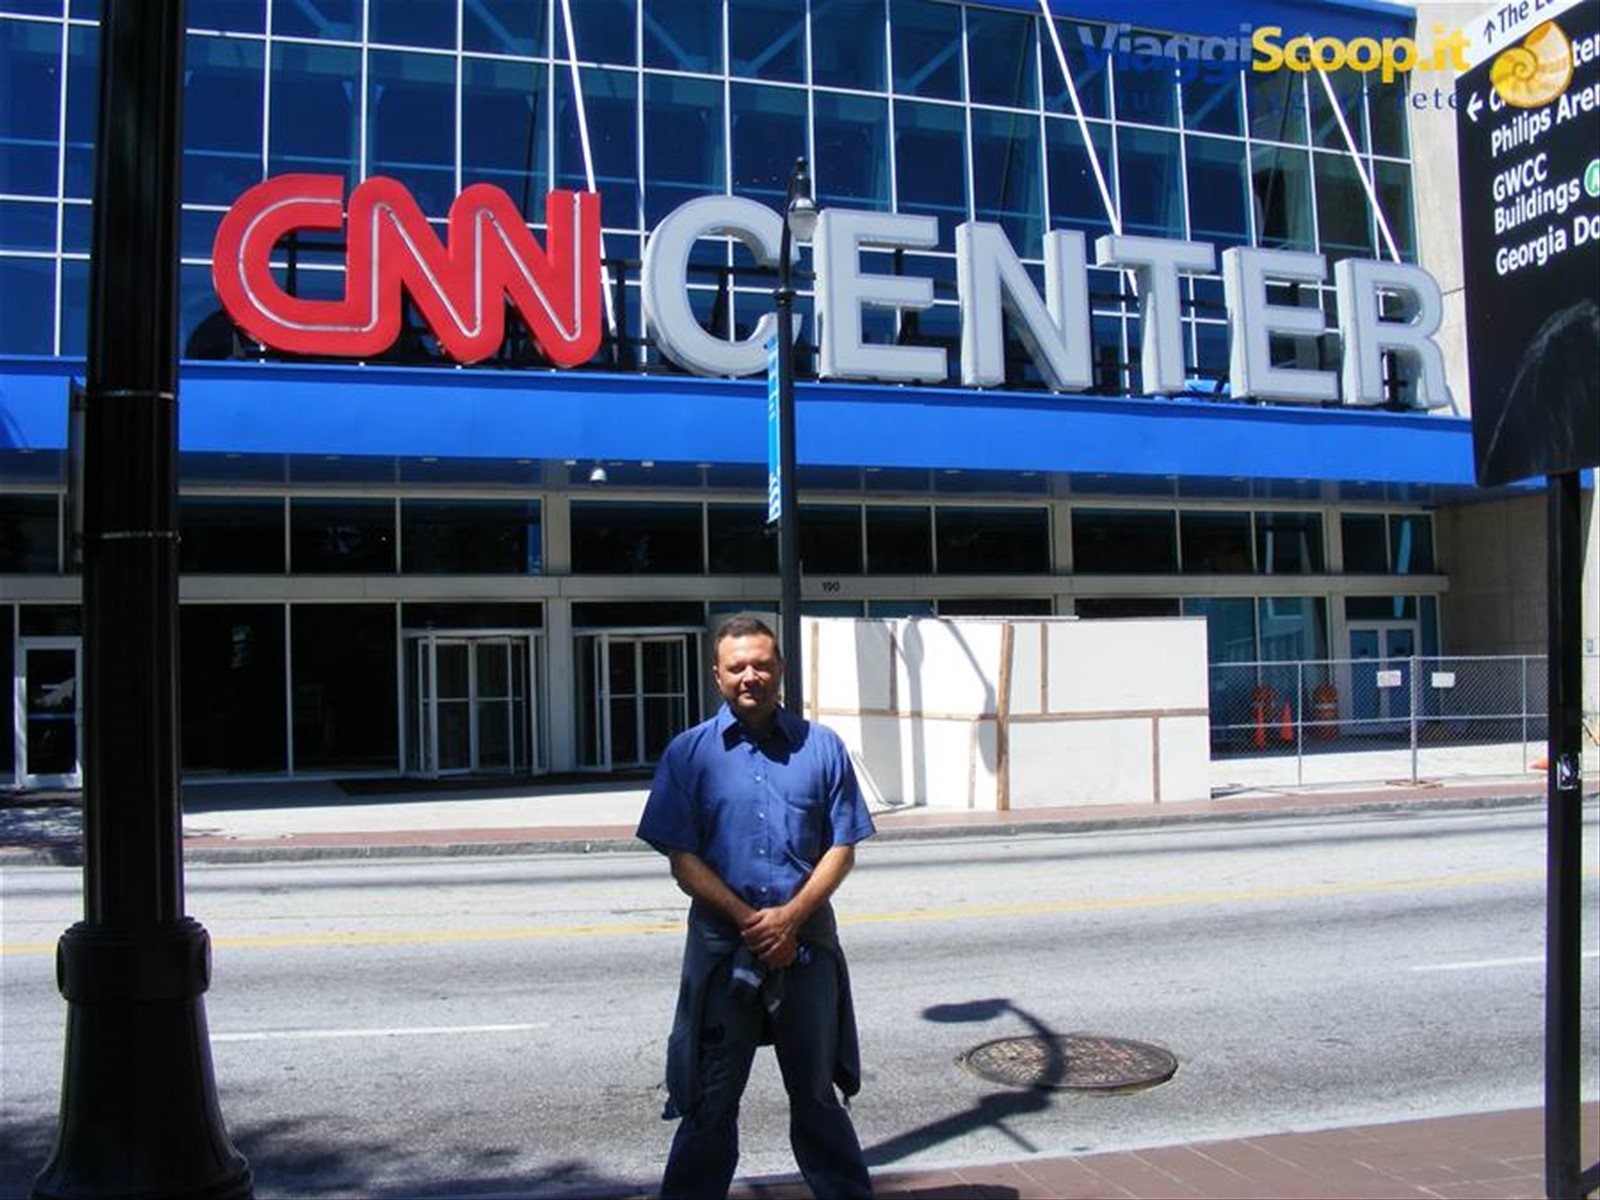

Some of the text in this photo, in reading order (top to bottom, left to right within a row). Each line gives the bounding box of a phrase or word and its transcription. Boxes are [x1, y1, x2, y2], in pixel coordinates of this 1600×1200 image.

[1497, 0, 1530, 33] The
[1491, 107, 1552, 158] Philips
[1492, 153, 1548, 202] GWCC
[1493, 177, 1581, 235] Buildings
[1495, 224, 1568, 276] Georgia
[211, 173, 1449, 409] CNN CENTER
